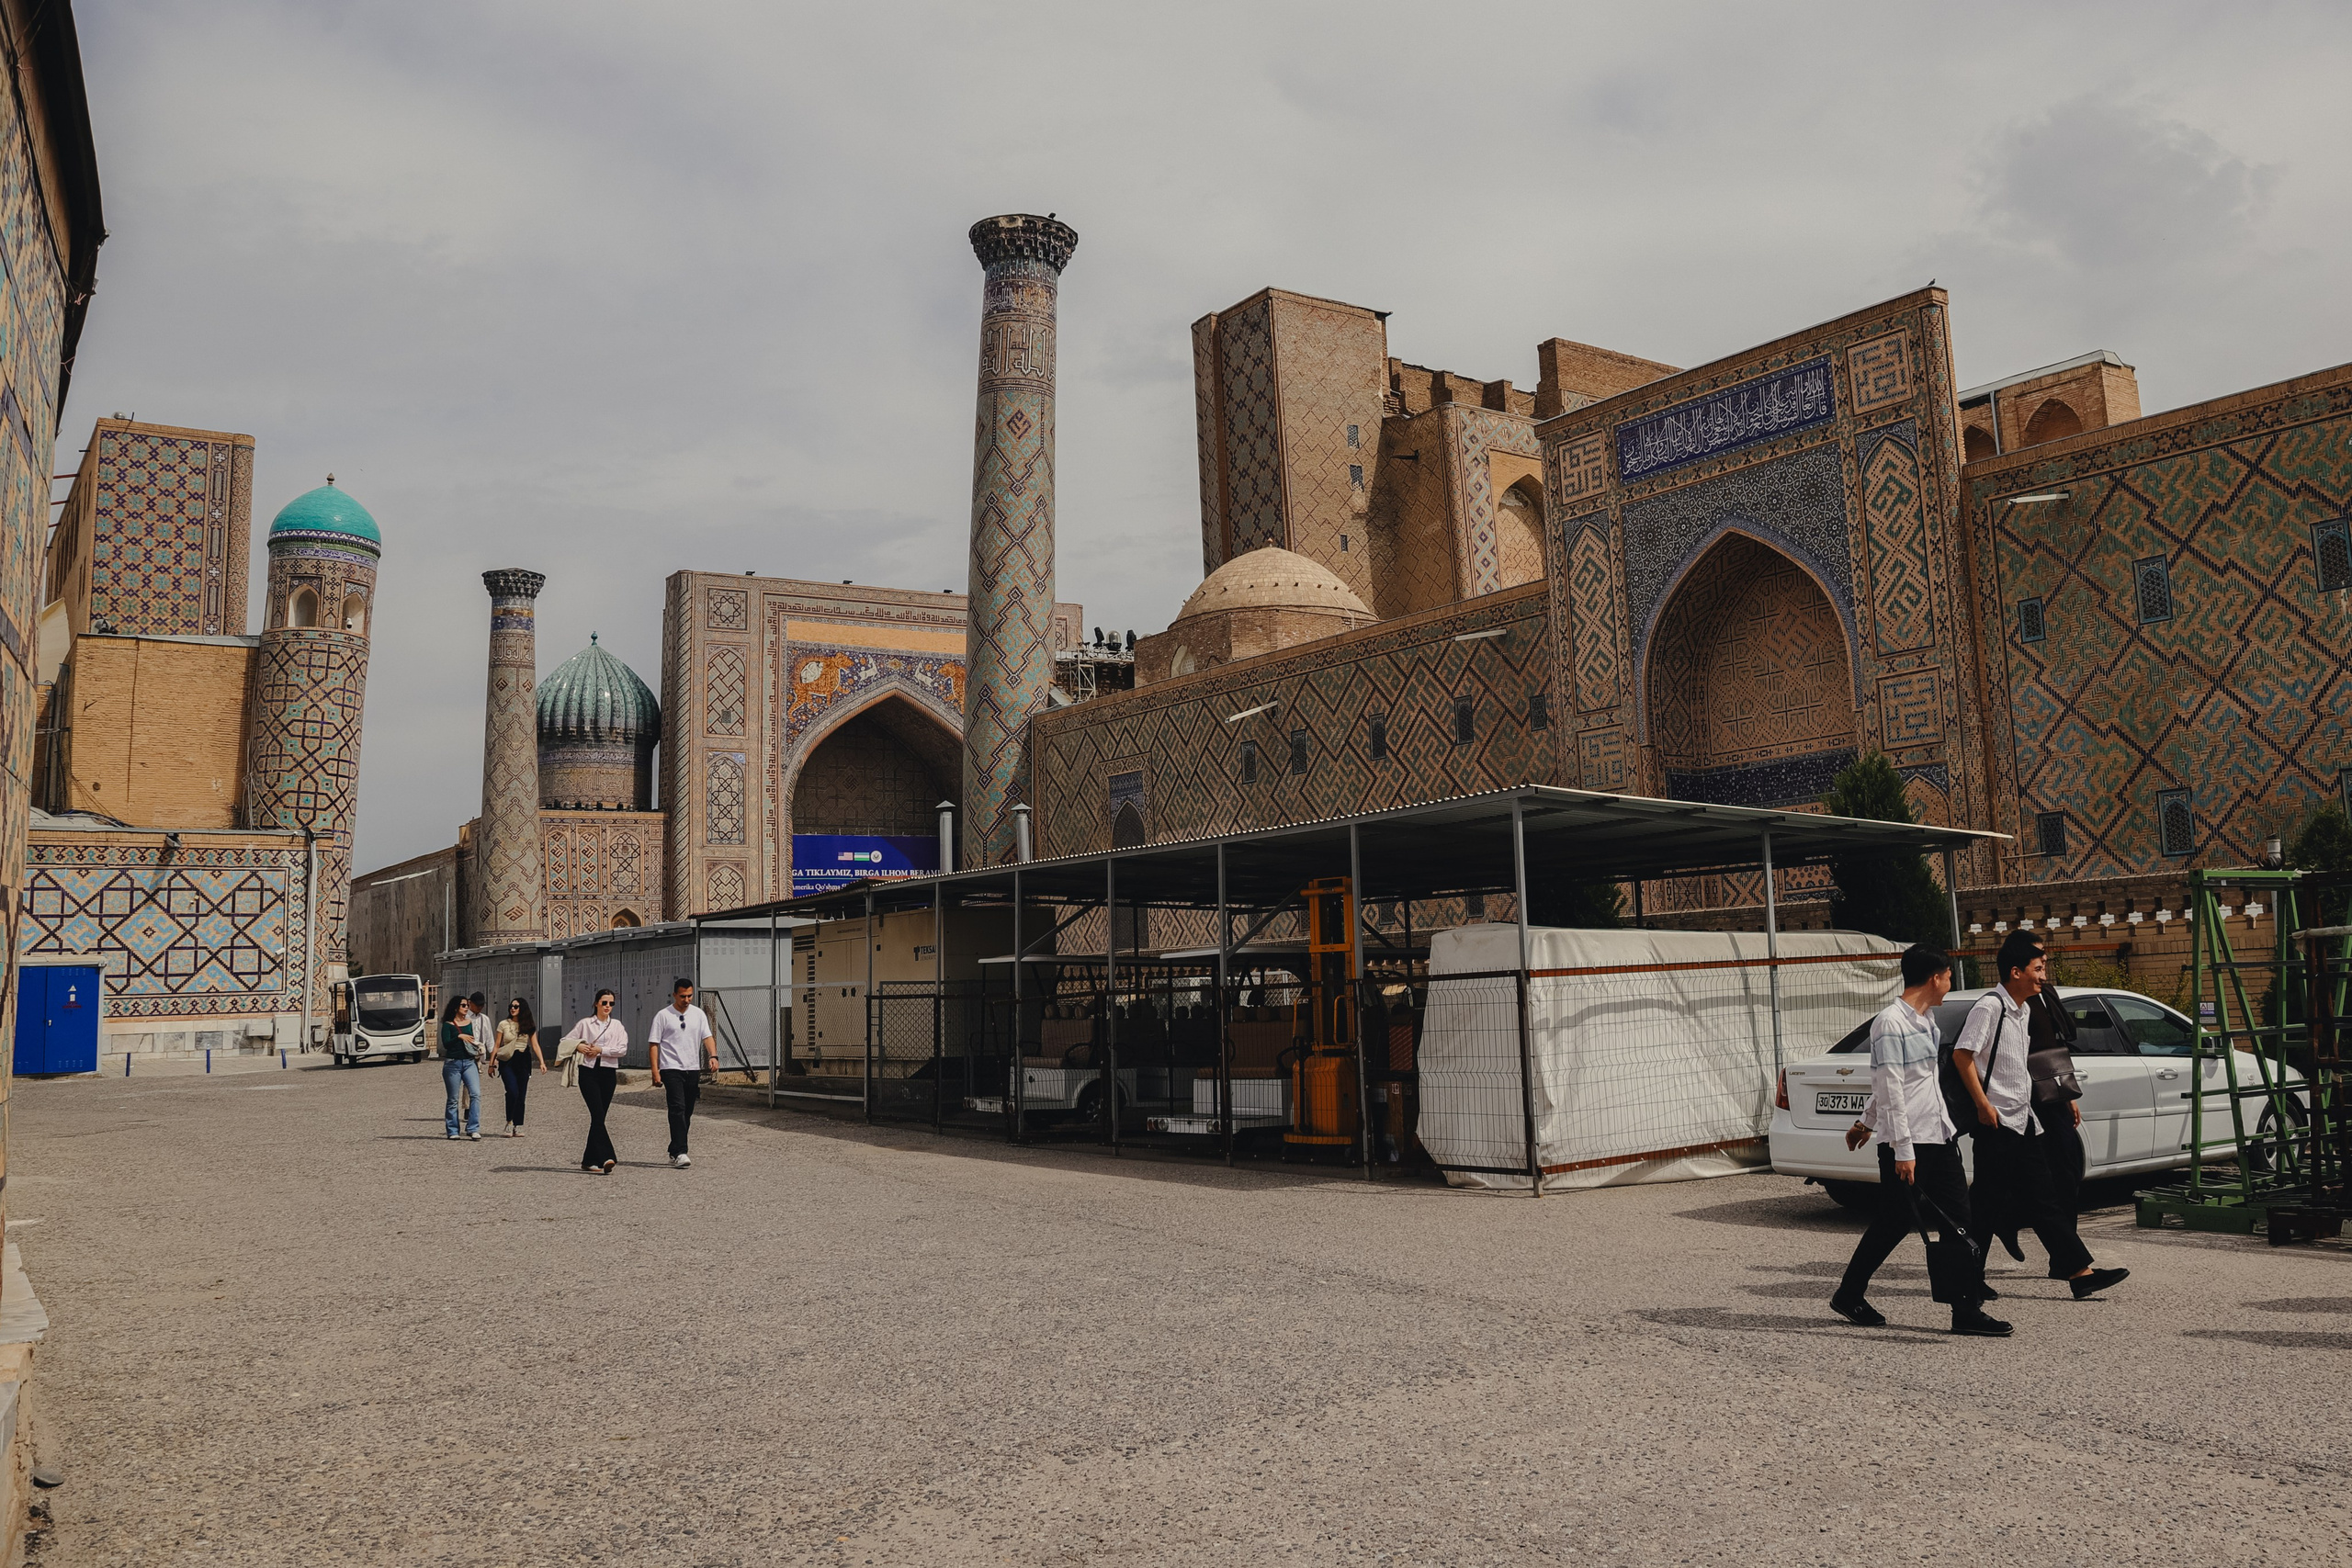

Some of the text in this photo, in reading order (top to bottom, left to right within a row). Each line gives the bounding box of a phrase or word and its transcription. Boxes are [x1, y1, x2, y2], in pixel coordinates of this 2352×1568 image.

[805, 869, 853, 877] TIKLAYMIZ,
[854, 869, 879, 877] BIRGA
[881, 869, 908, 877] ILHOM
[921, 946, 936, 954] TEKSA
[1819, 1097, 1828, 1107] 30
[1829, 1096, 1848, 1109] 373
